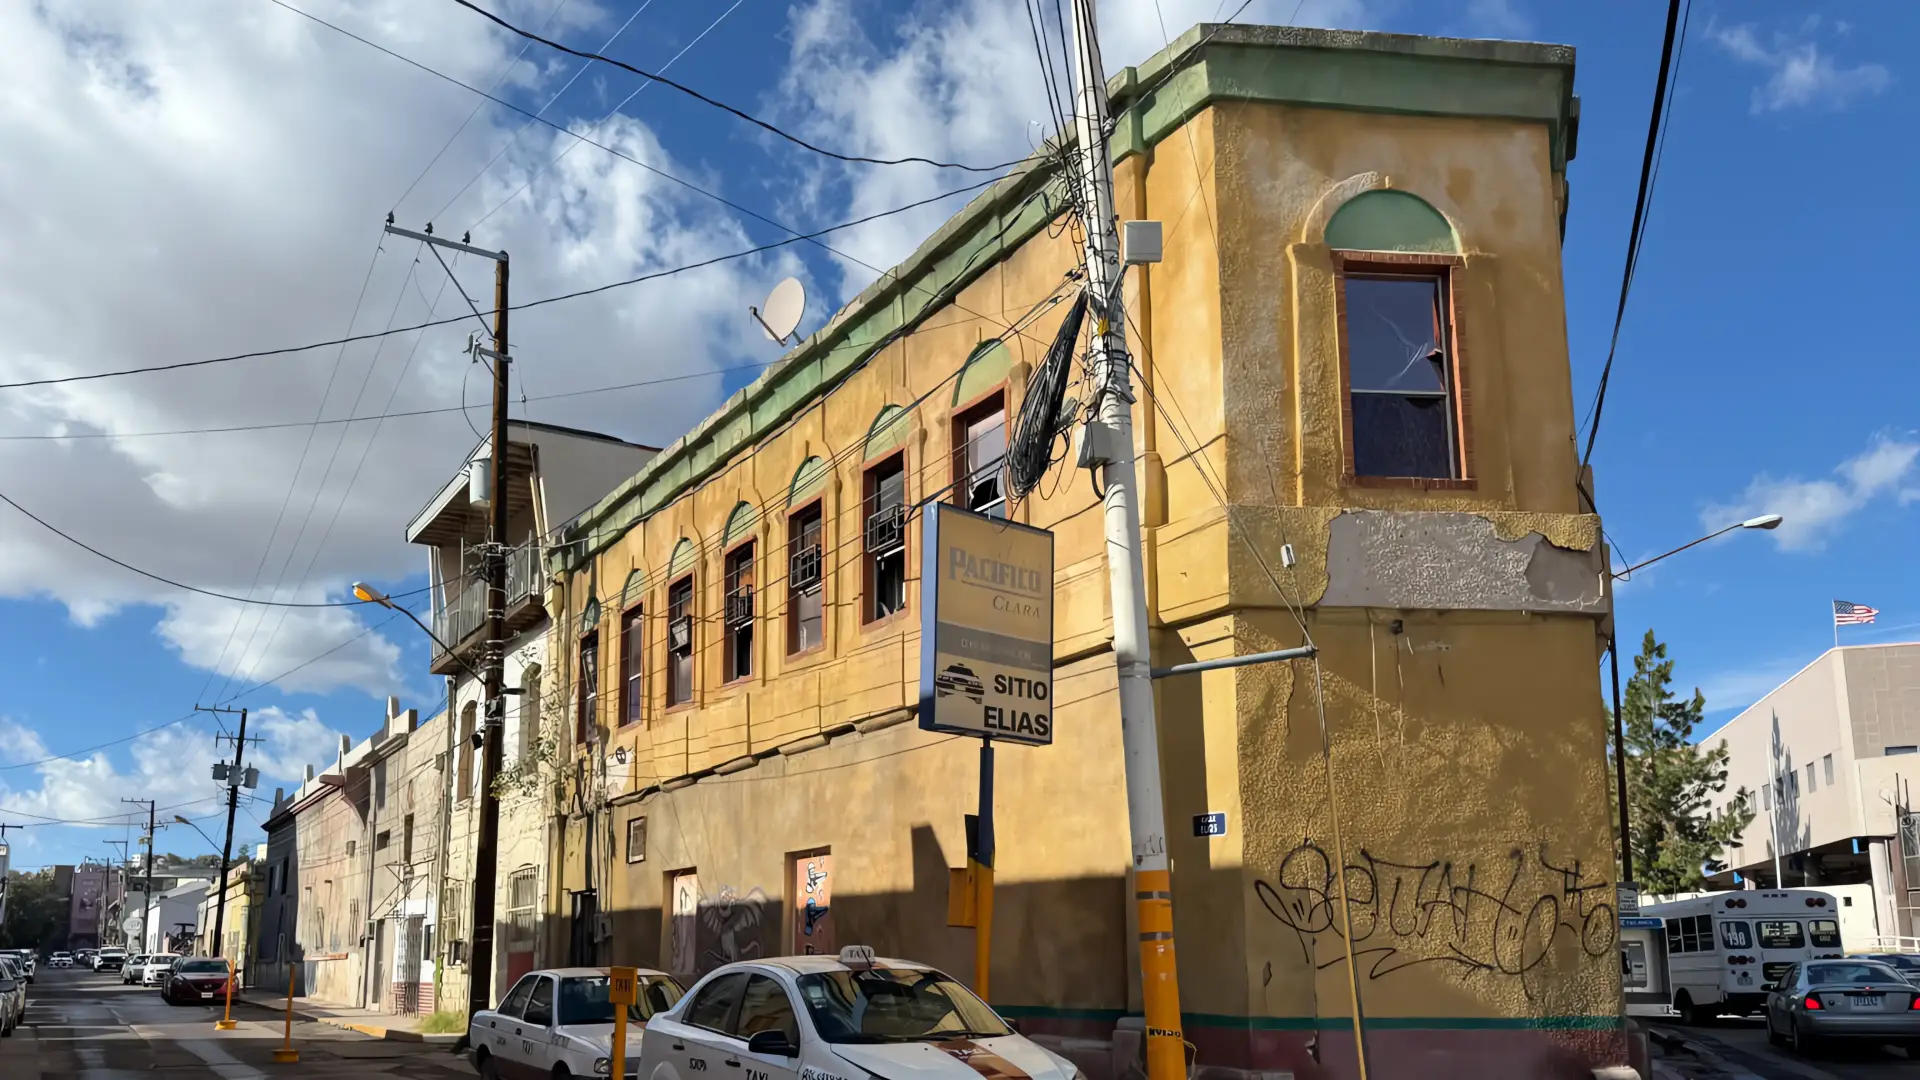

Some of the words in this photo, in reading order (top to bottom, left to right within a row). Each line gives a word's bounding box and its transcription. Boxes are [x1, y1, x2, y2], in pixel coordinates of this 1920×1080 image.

[949, 545, 1043, 594] PACIFICO
[992, 595, 1041, 620] CLARA
[993, 674, 1048, 701] SITIO
[983, 706, 1049, 737] ELIAS
